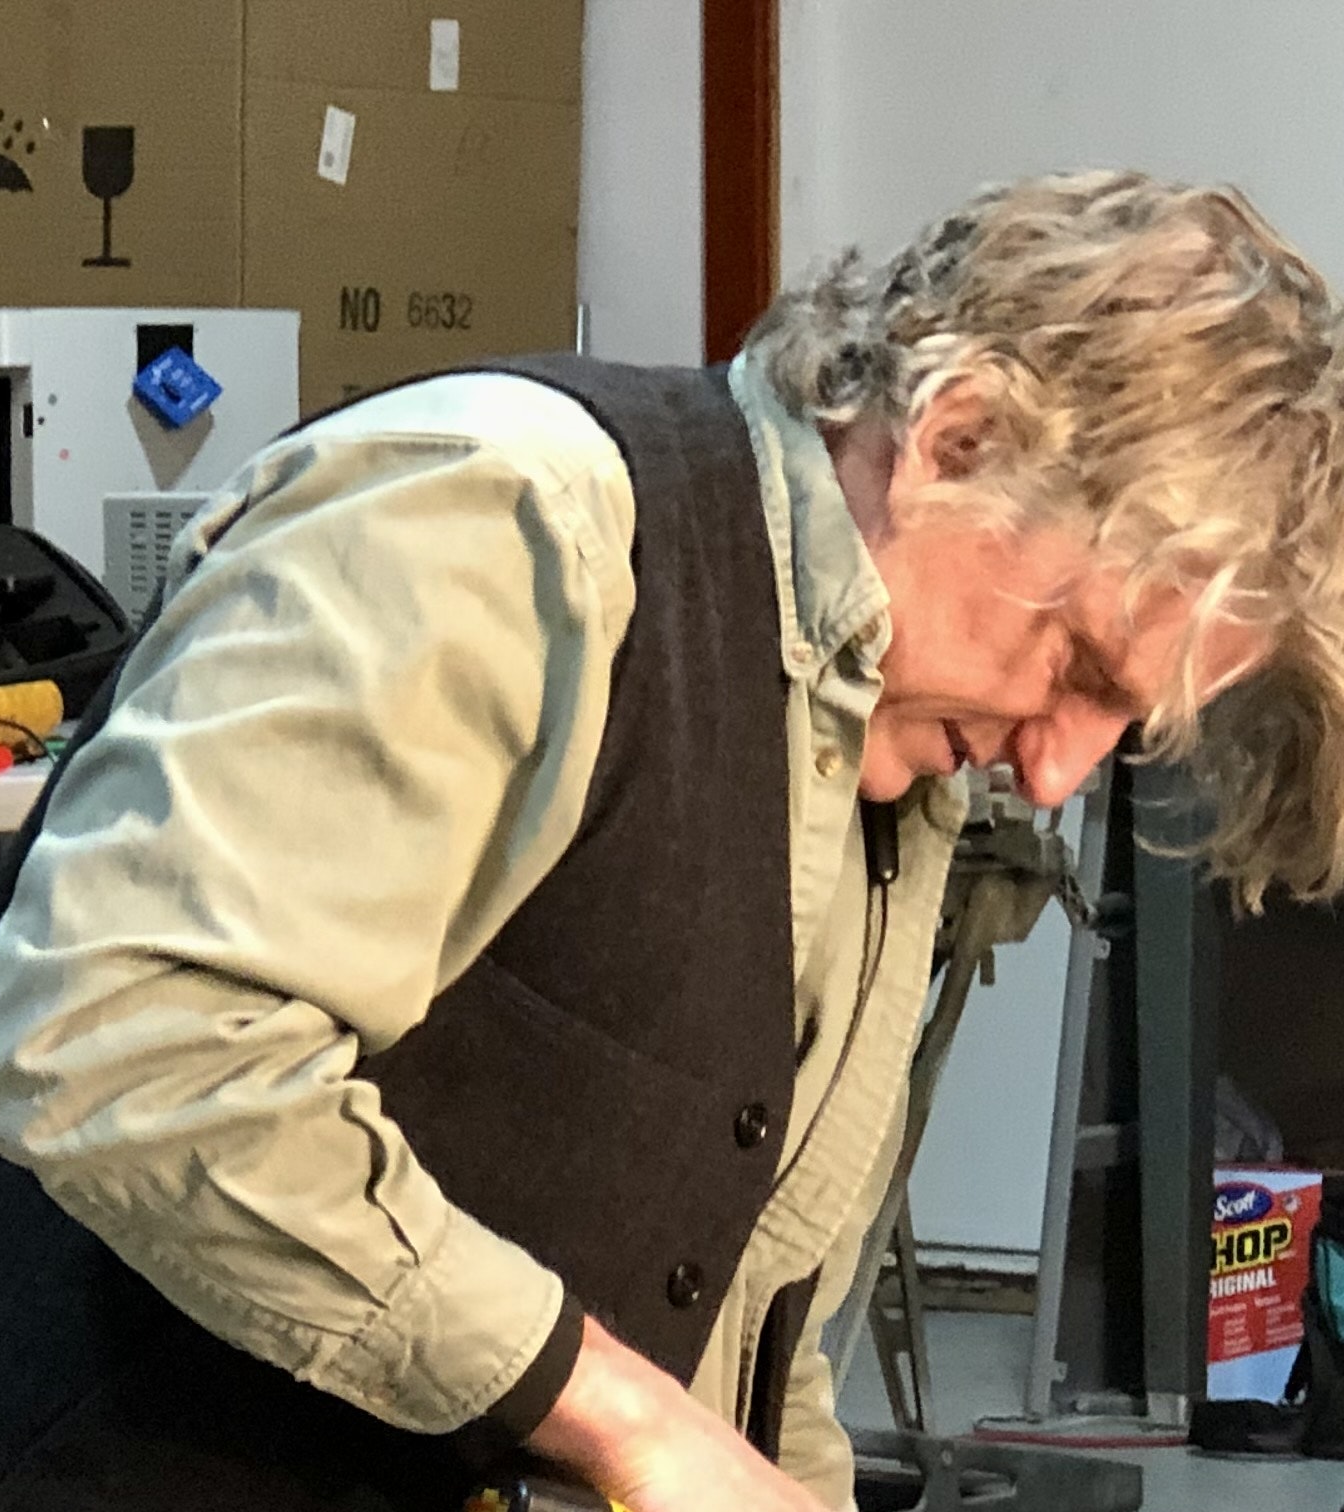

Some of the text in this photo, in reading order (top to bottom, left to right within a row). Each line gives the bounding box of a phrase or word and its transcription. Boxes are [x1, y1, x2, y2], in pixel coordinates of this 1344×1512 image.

[340, 286, 473, 332] NO 6632
[1213, 1190, 1256, 1221] Scott
[1210, 1219, 1290, 1270] HOP
[1209, 1266, 1277, 1299] RIGINAL
